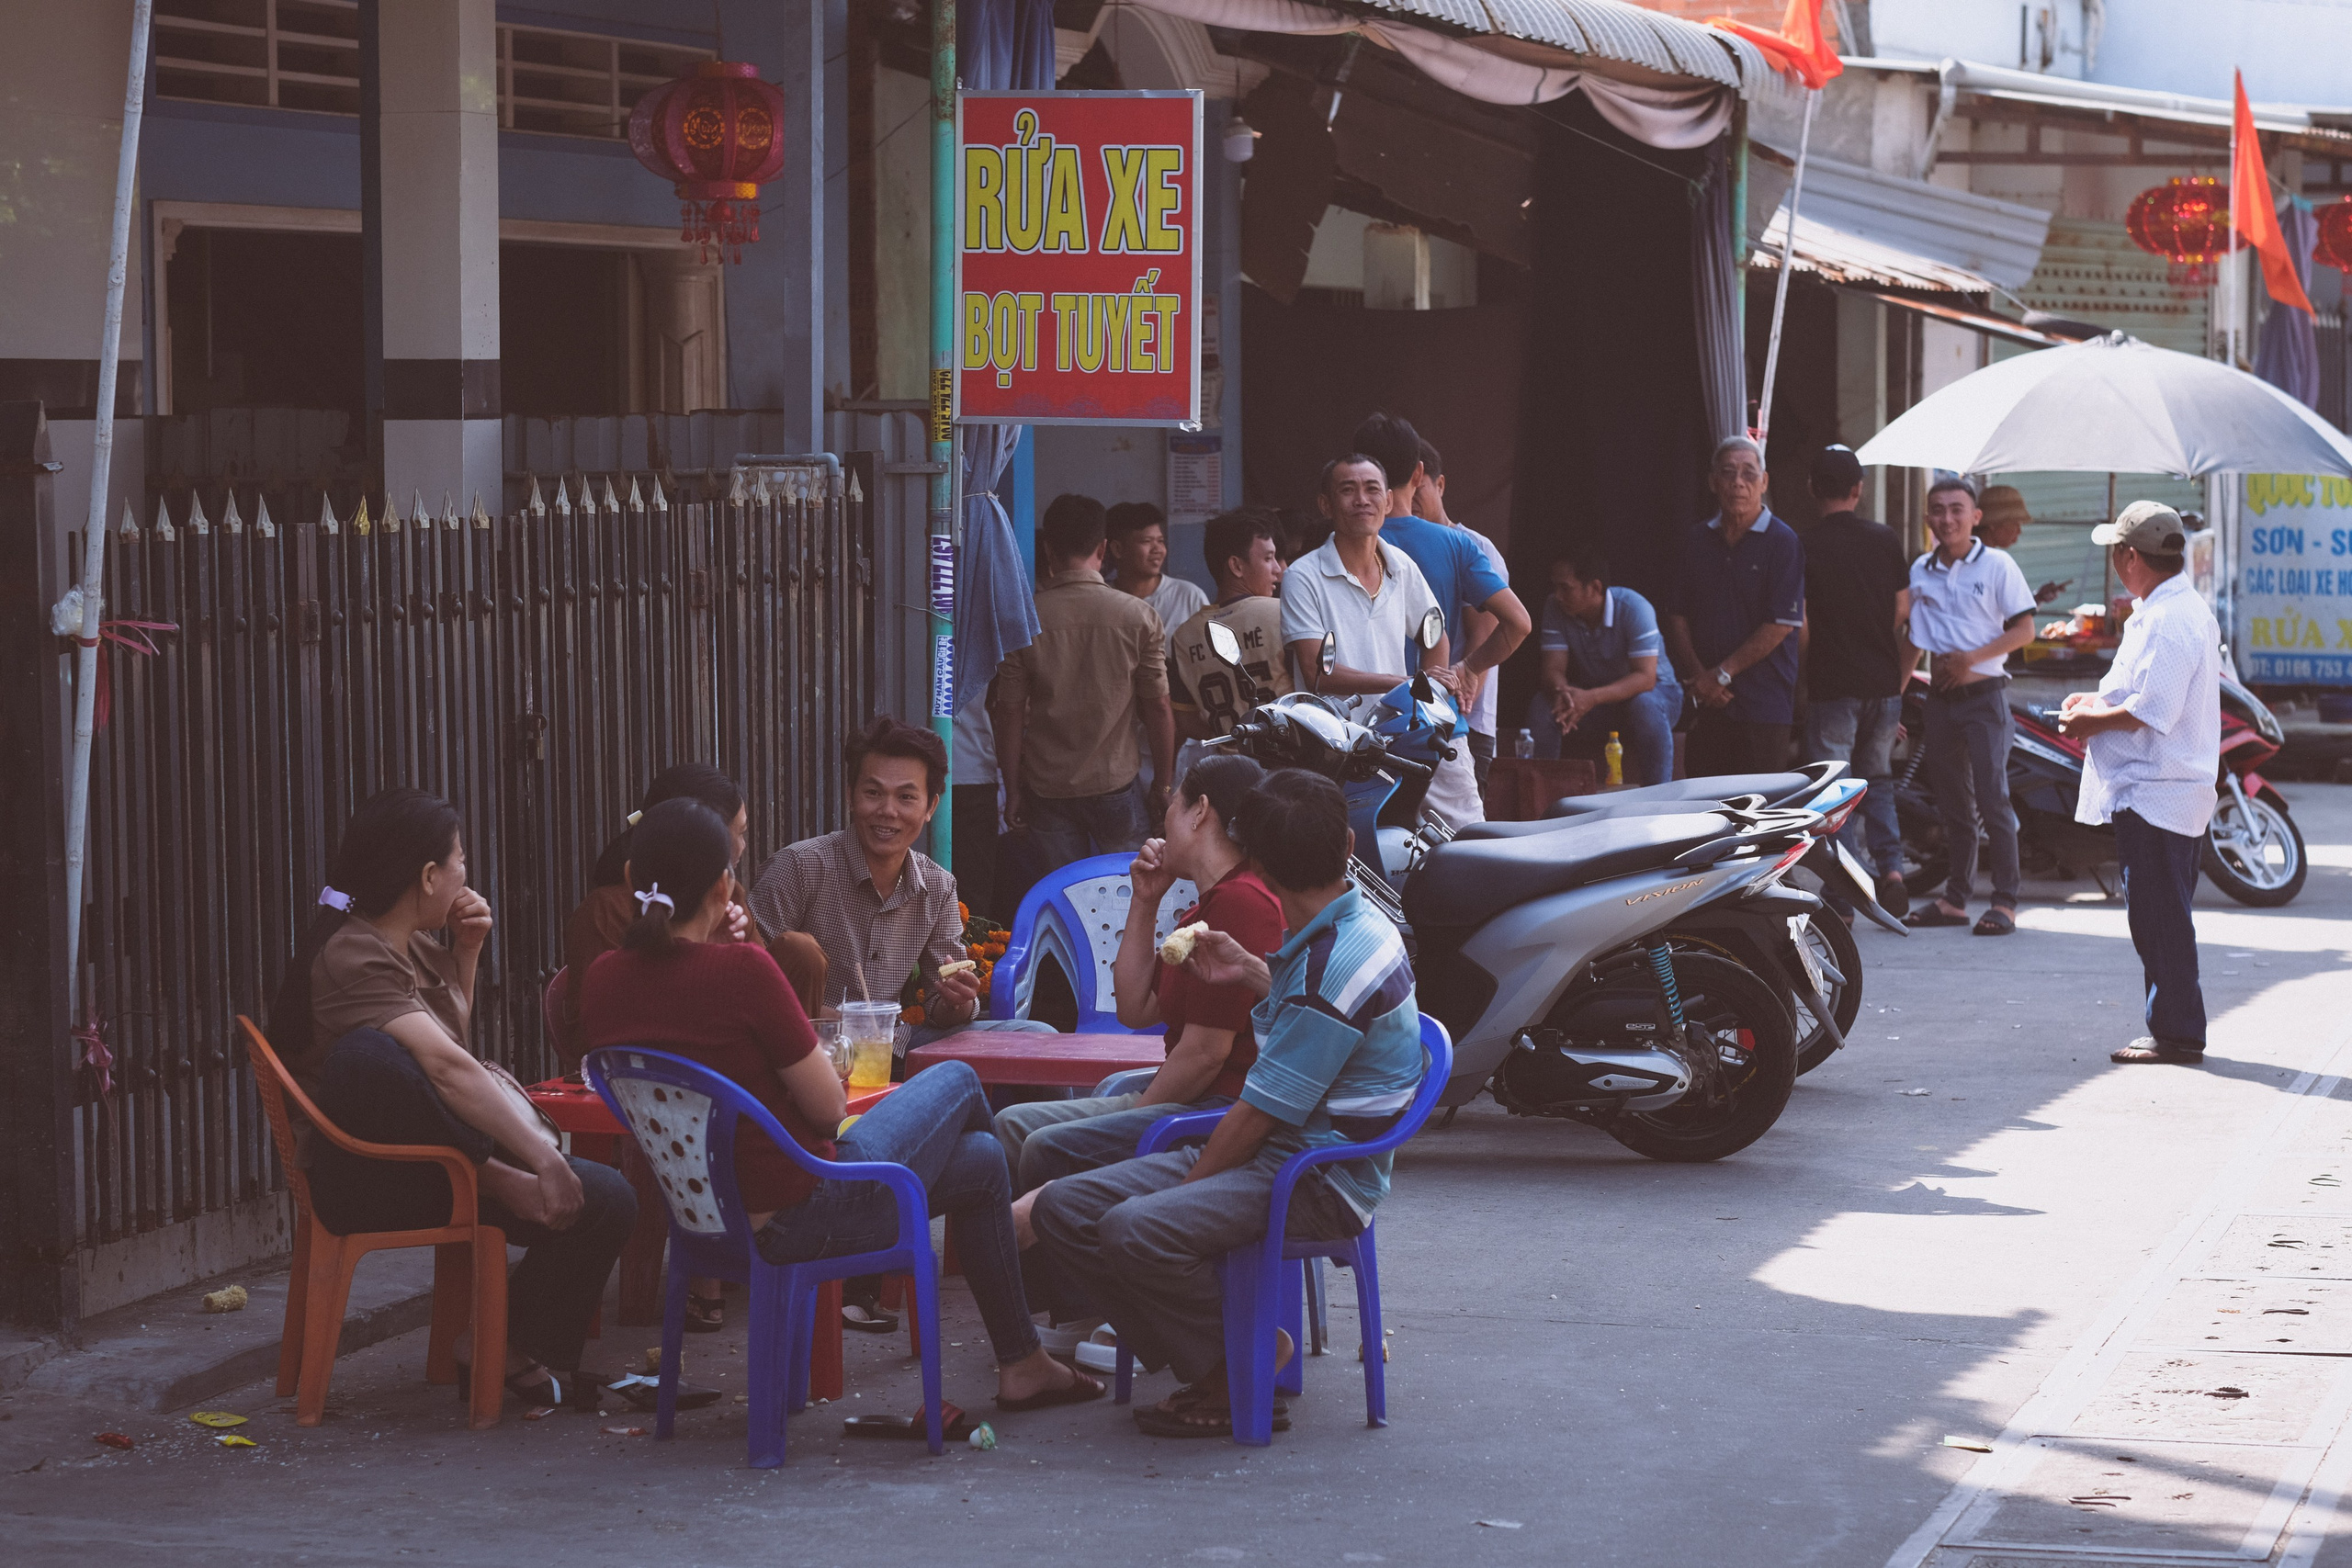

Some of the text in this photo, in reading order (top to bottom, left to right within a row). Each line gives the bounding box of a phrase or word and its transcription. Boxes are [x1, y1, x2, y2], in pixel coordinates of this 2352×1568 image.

[963, 108, 1182, 253] RỬA XE
[963, 292, 1043, 388] BỌT
[1052, 269, 1180, 372] TUYẾT
[2315, 569, 2333, 596] XE
[2251, 605, 2326, 649] RỬA
[1189, 644, 1205, 664] FC
[1625, 877, 1704, 906] VISION
